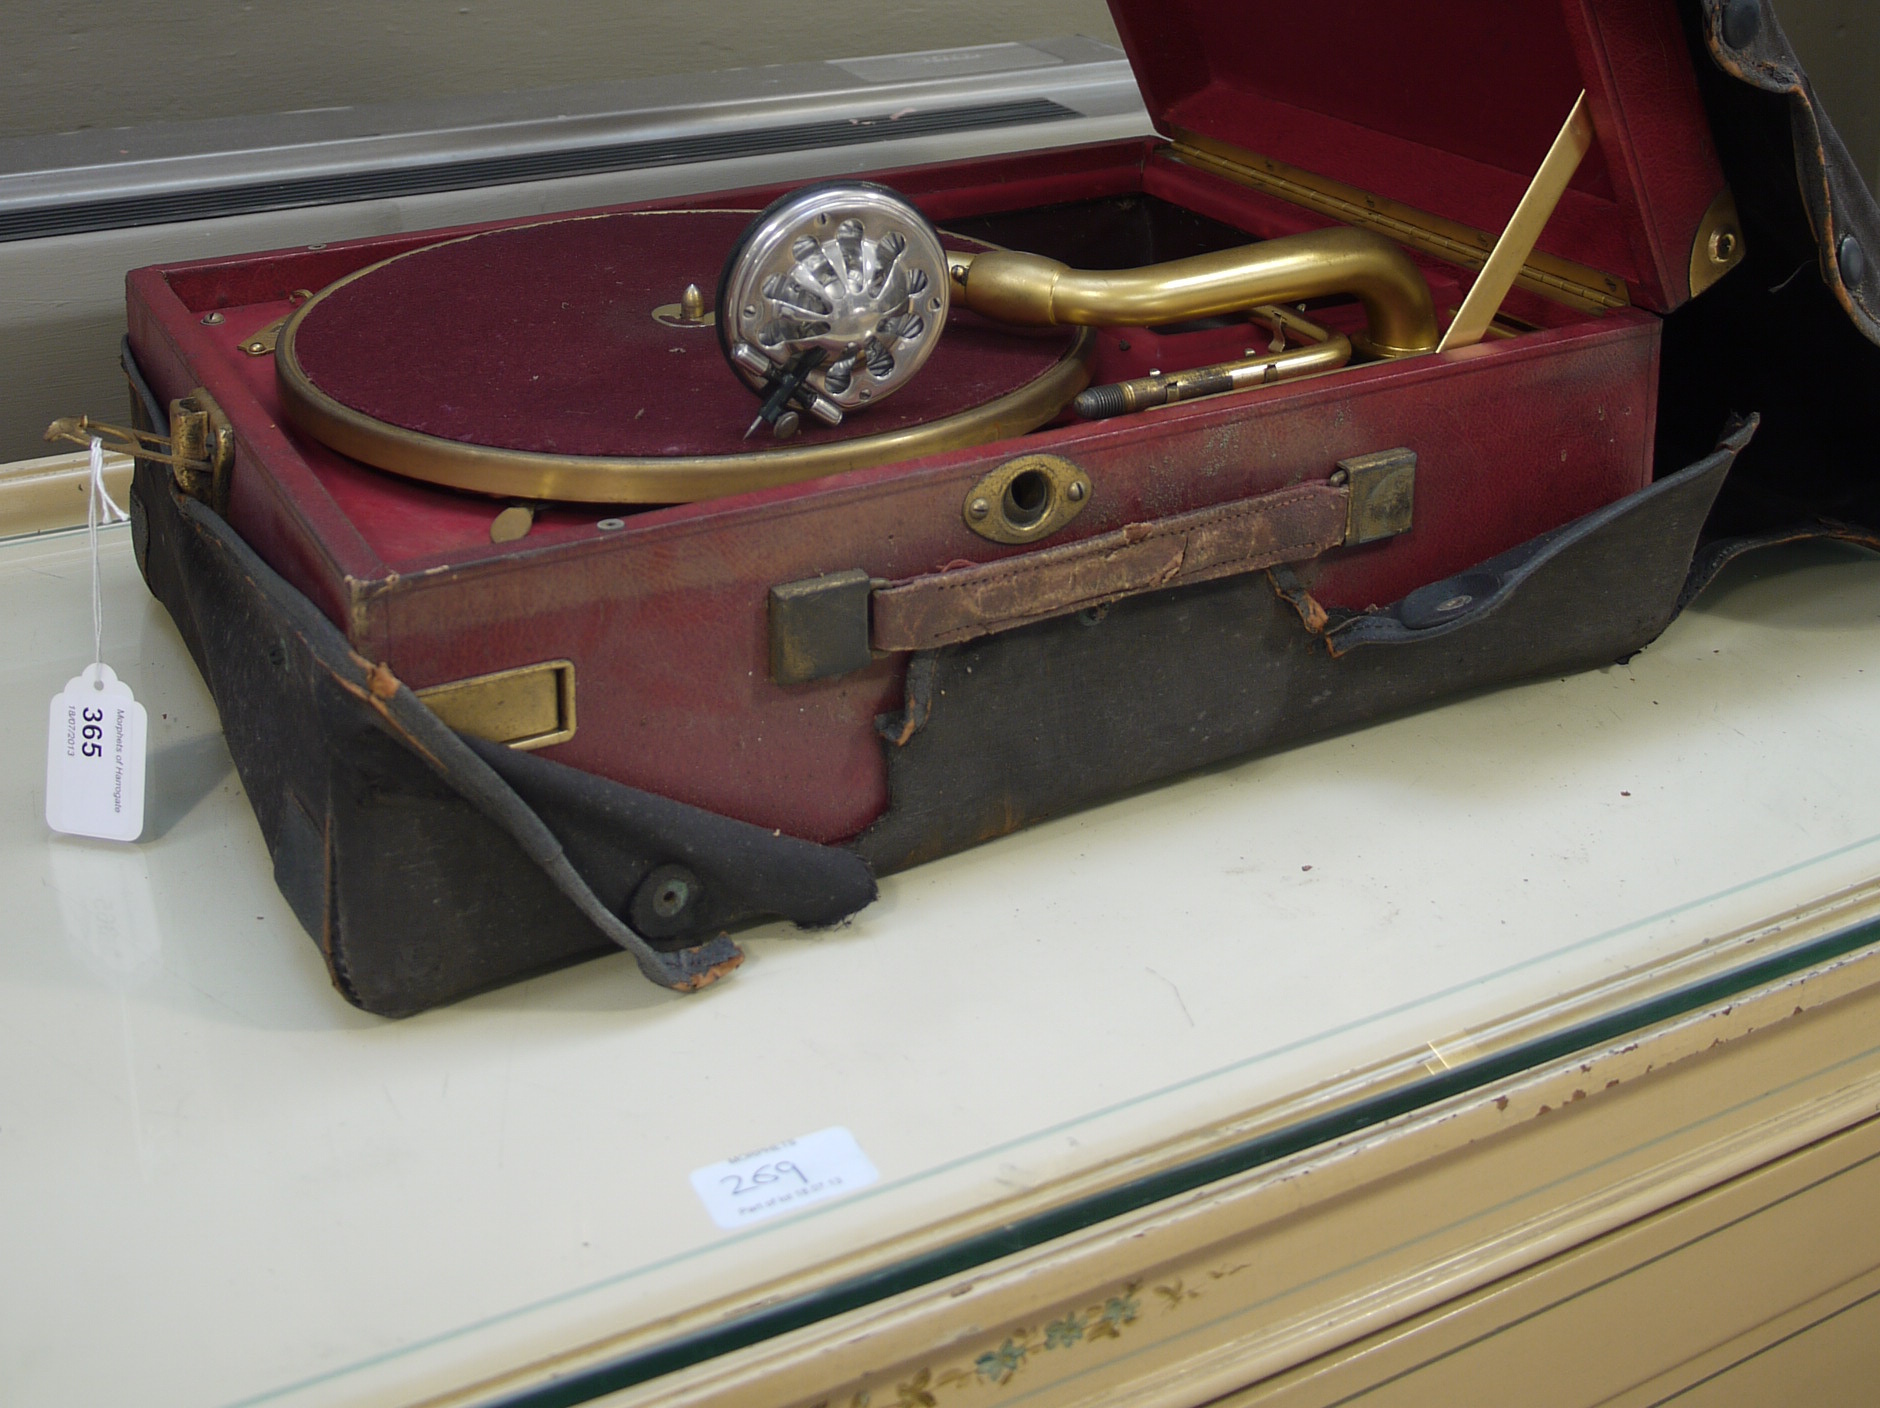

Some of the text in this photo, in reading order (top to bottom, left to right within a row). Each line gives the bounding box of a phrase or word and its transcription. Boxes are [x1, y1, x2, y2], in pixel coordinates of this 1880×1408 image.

[67, 705, 76, 757] 18/07/2013
[82, 706, 103, 758] 365
[113, 708, 125, 814] Morphets of Harrogate
[719, 1160, 809, 1196] 269
